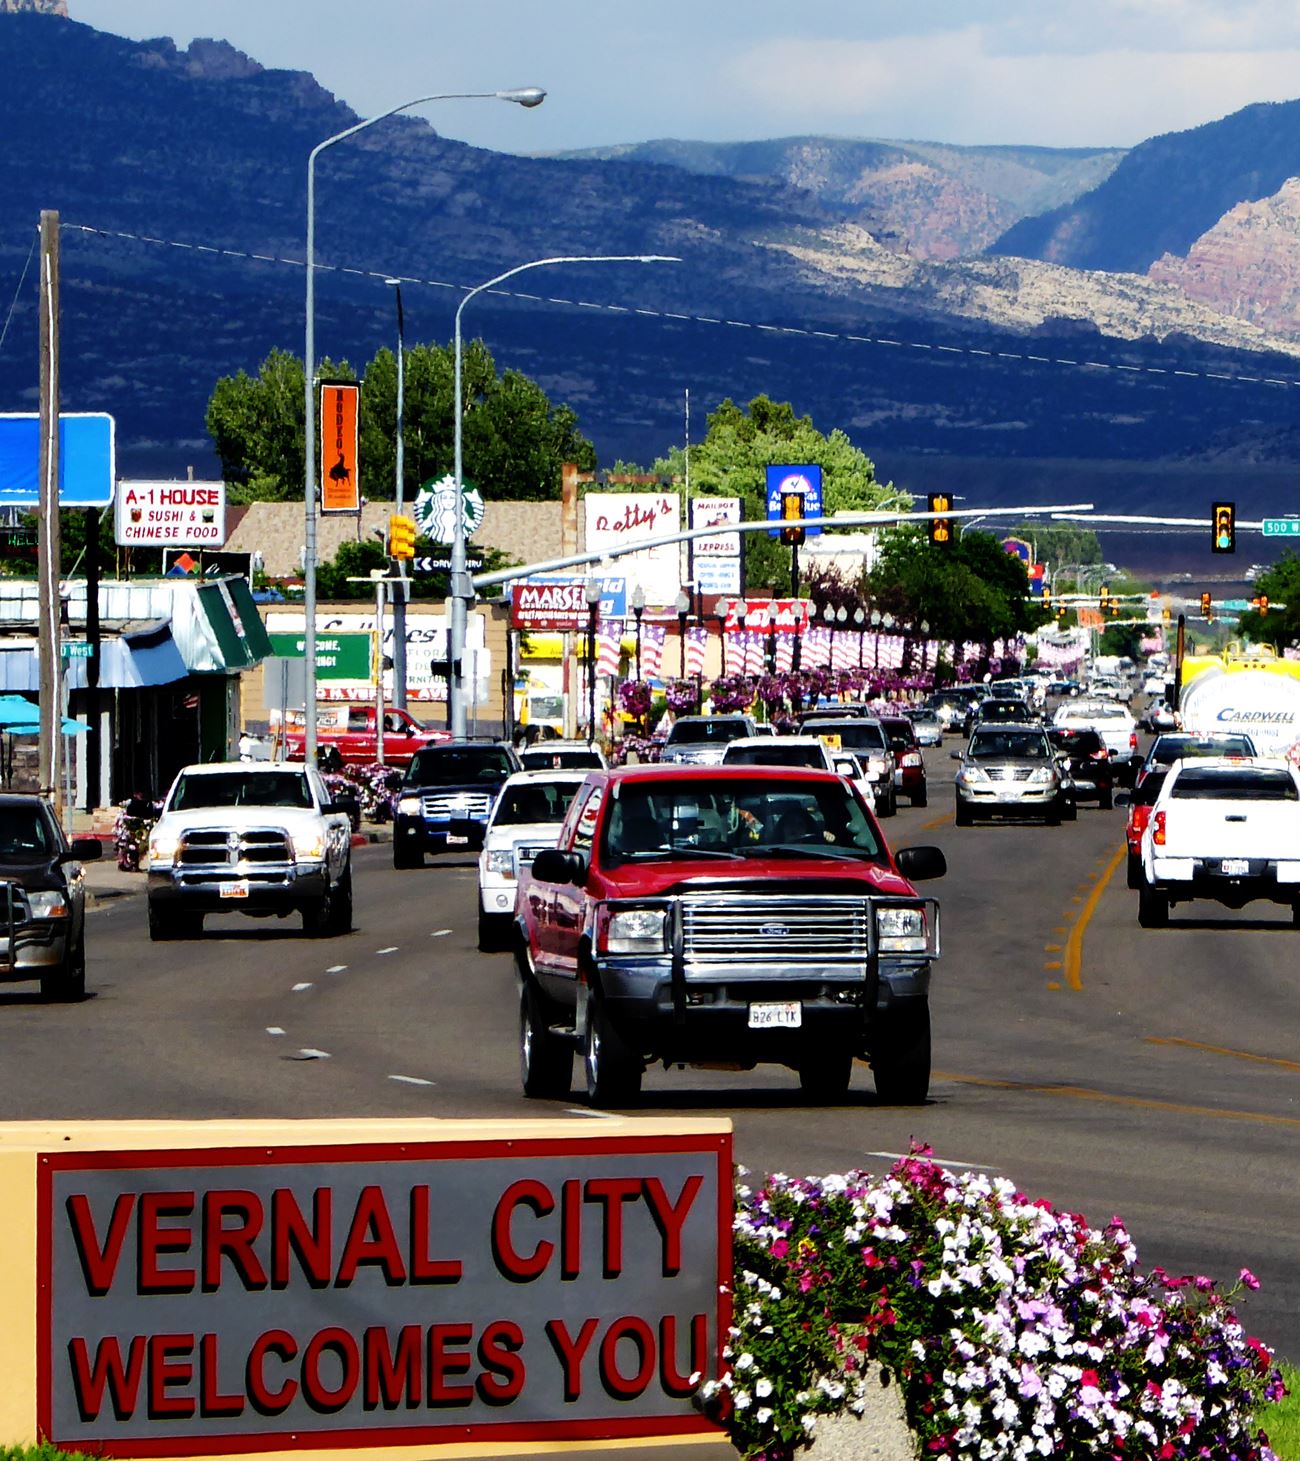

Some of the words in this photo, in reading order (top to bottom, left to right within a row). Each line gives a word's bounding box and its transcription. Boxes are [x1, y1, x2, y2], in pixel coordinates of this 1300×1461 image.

[126, 488, 154, 505] A-1
[160, 488, 219, 506] HOUSE
[697, 502, 735, 510] MAILBOX
[148, 510, 183, 521] SUSHI
[189, 510, 197, 521] &
[125, 526, 180, 538] CHINESE
[185, 526, 218, 538] FOOD
[1267, 523, 1287, 532] 500
[465, 559, 482, 569] HRU
[1216, 707, 1296, 722] CARDWELL
[66, 1184, 462, 1296] VERNAL
[493, 1175, 704, 1283] CITY
[69, 1319, 526, 1422] WELCOMES
[546, 1313, 708, 1402] YOU
